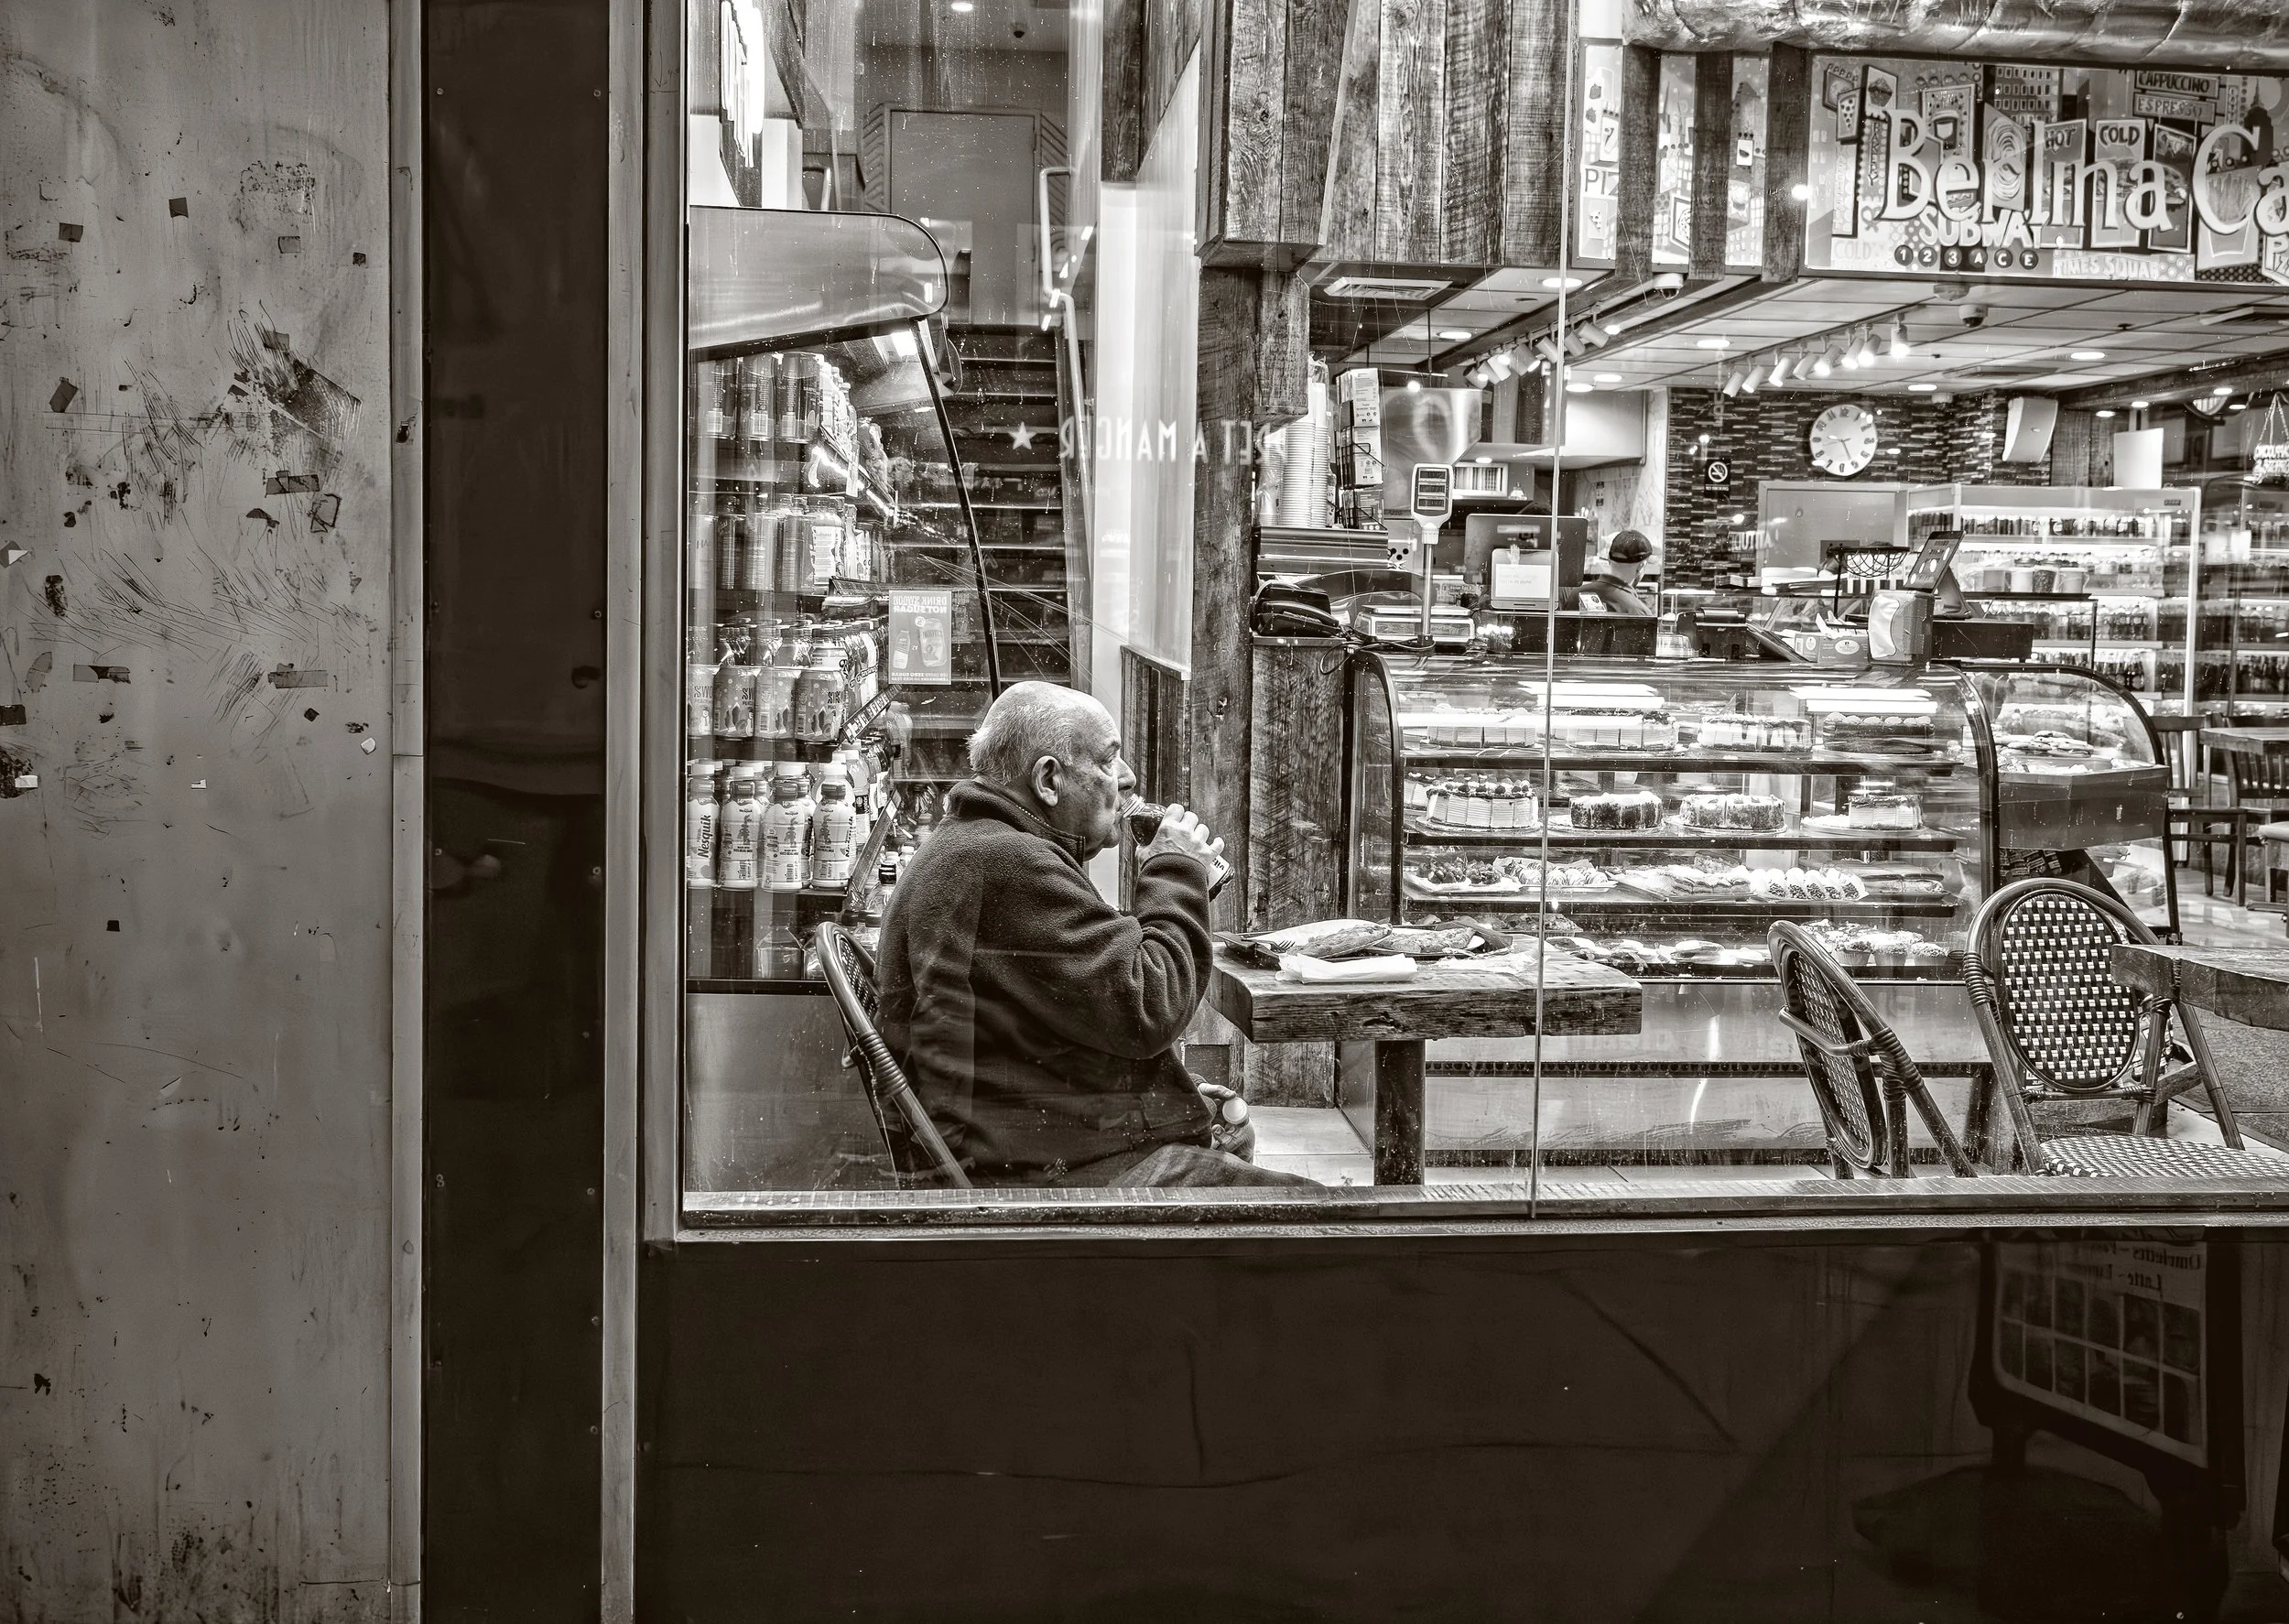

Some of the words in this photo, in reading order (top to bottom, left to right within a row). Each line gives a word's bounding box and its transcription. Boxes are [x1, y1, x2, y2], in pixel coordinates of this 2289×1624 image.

[2139, 70, 2210, 93] CAPPUCCINO
[2138, 98, 2203, 117] ESPRESSO
[2045, 127, 2077, 148] HOT
[2099, 125, 2141, 146] COLD
[1918, 202, 2050, 249] SUBWAY
[697, 814, 712, 858] Nesquik
